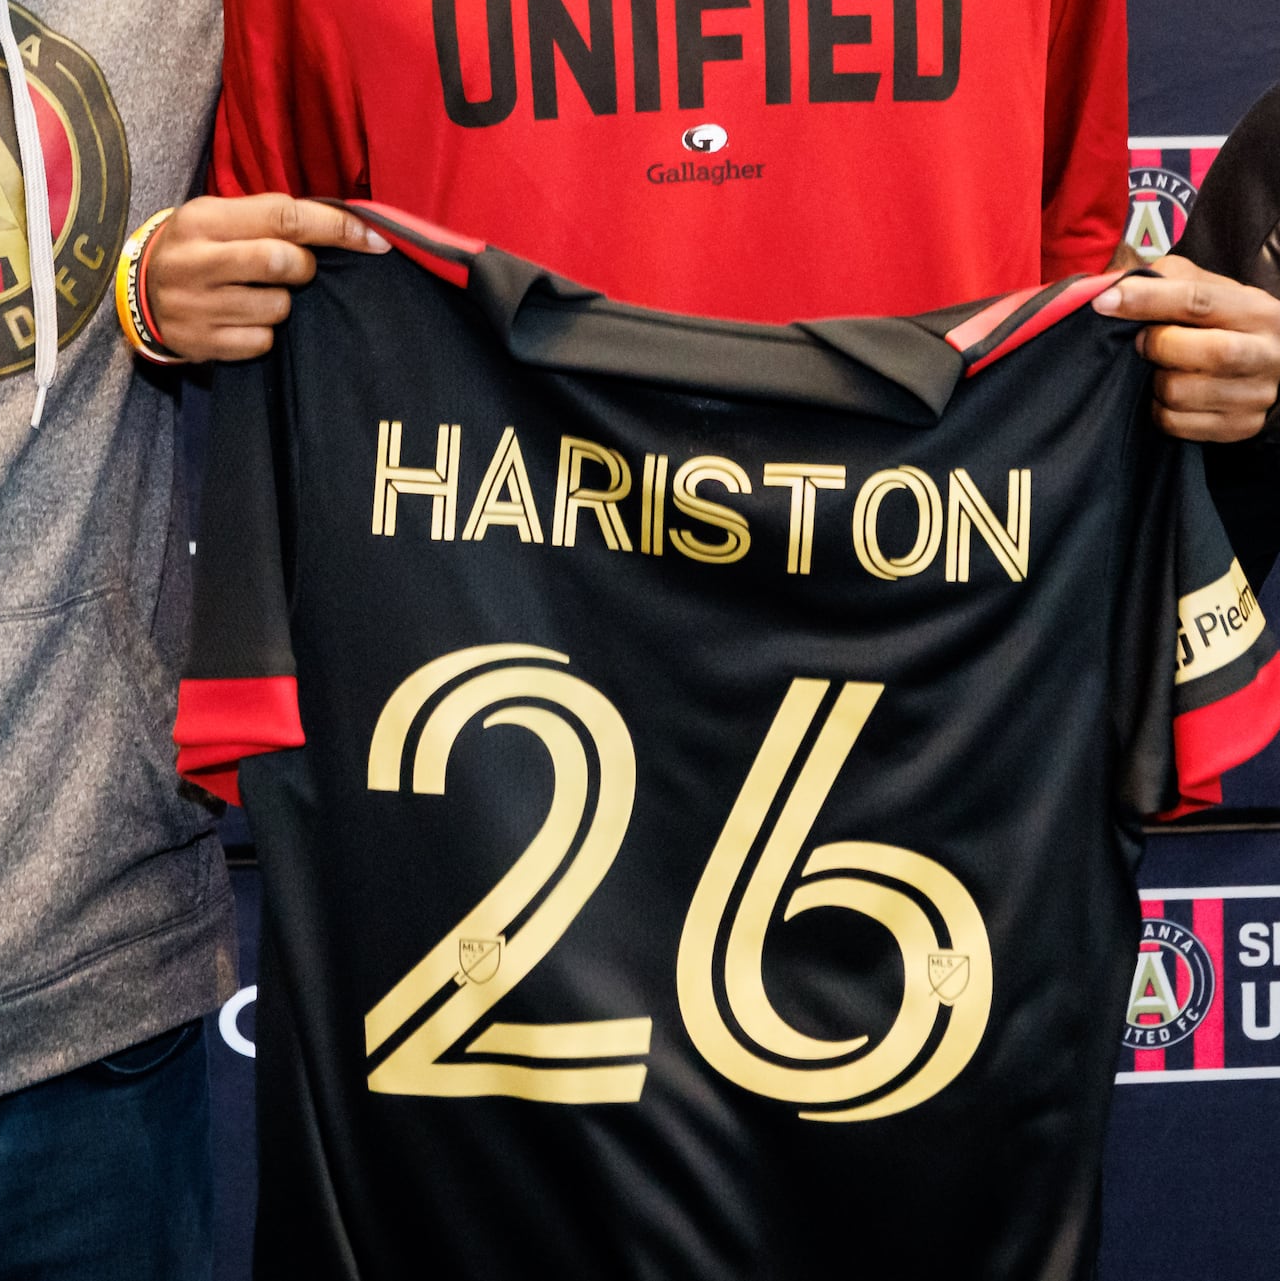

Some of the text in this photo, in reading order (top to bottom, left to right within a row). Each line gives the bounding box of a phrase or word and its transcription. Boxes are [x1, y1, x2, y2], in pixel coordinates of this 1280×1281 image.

[646, 159, 766, 186] Gallagher
[1128, 172, 1191, 204] LANTA
[55, 233, 106, 307] FC
[370, 419, 1033, 583] HARISTON
[364, 642, 994, 1123] 26
[1176, 1008, 1200, 1033] FC
